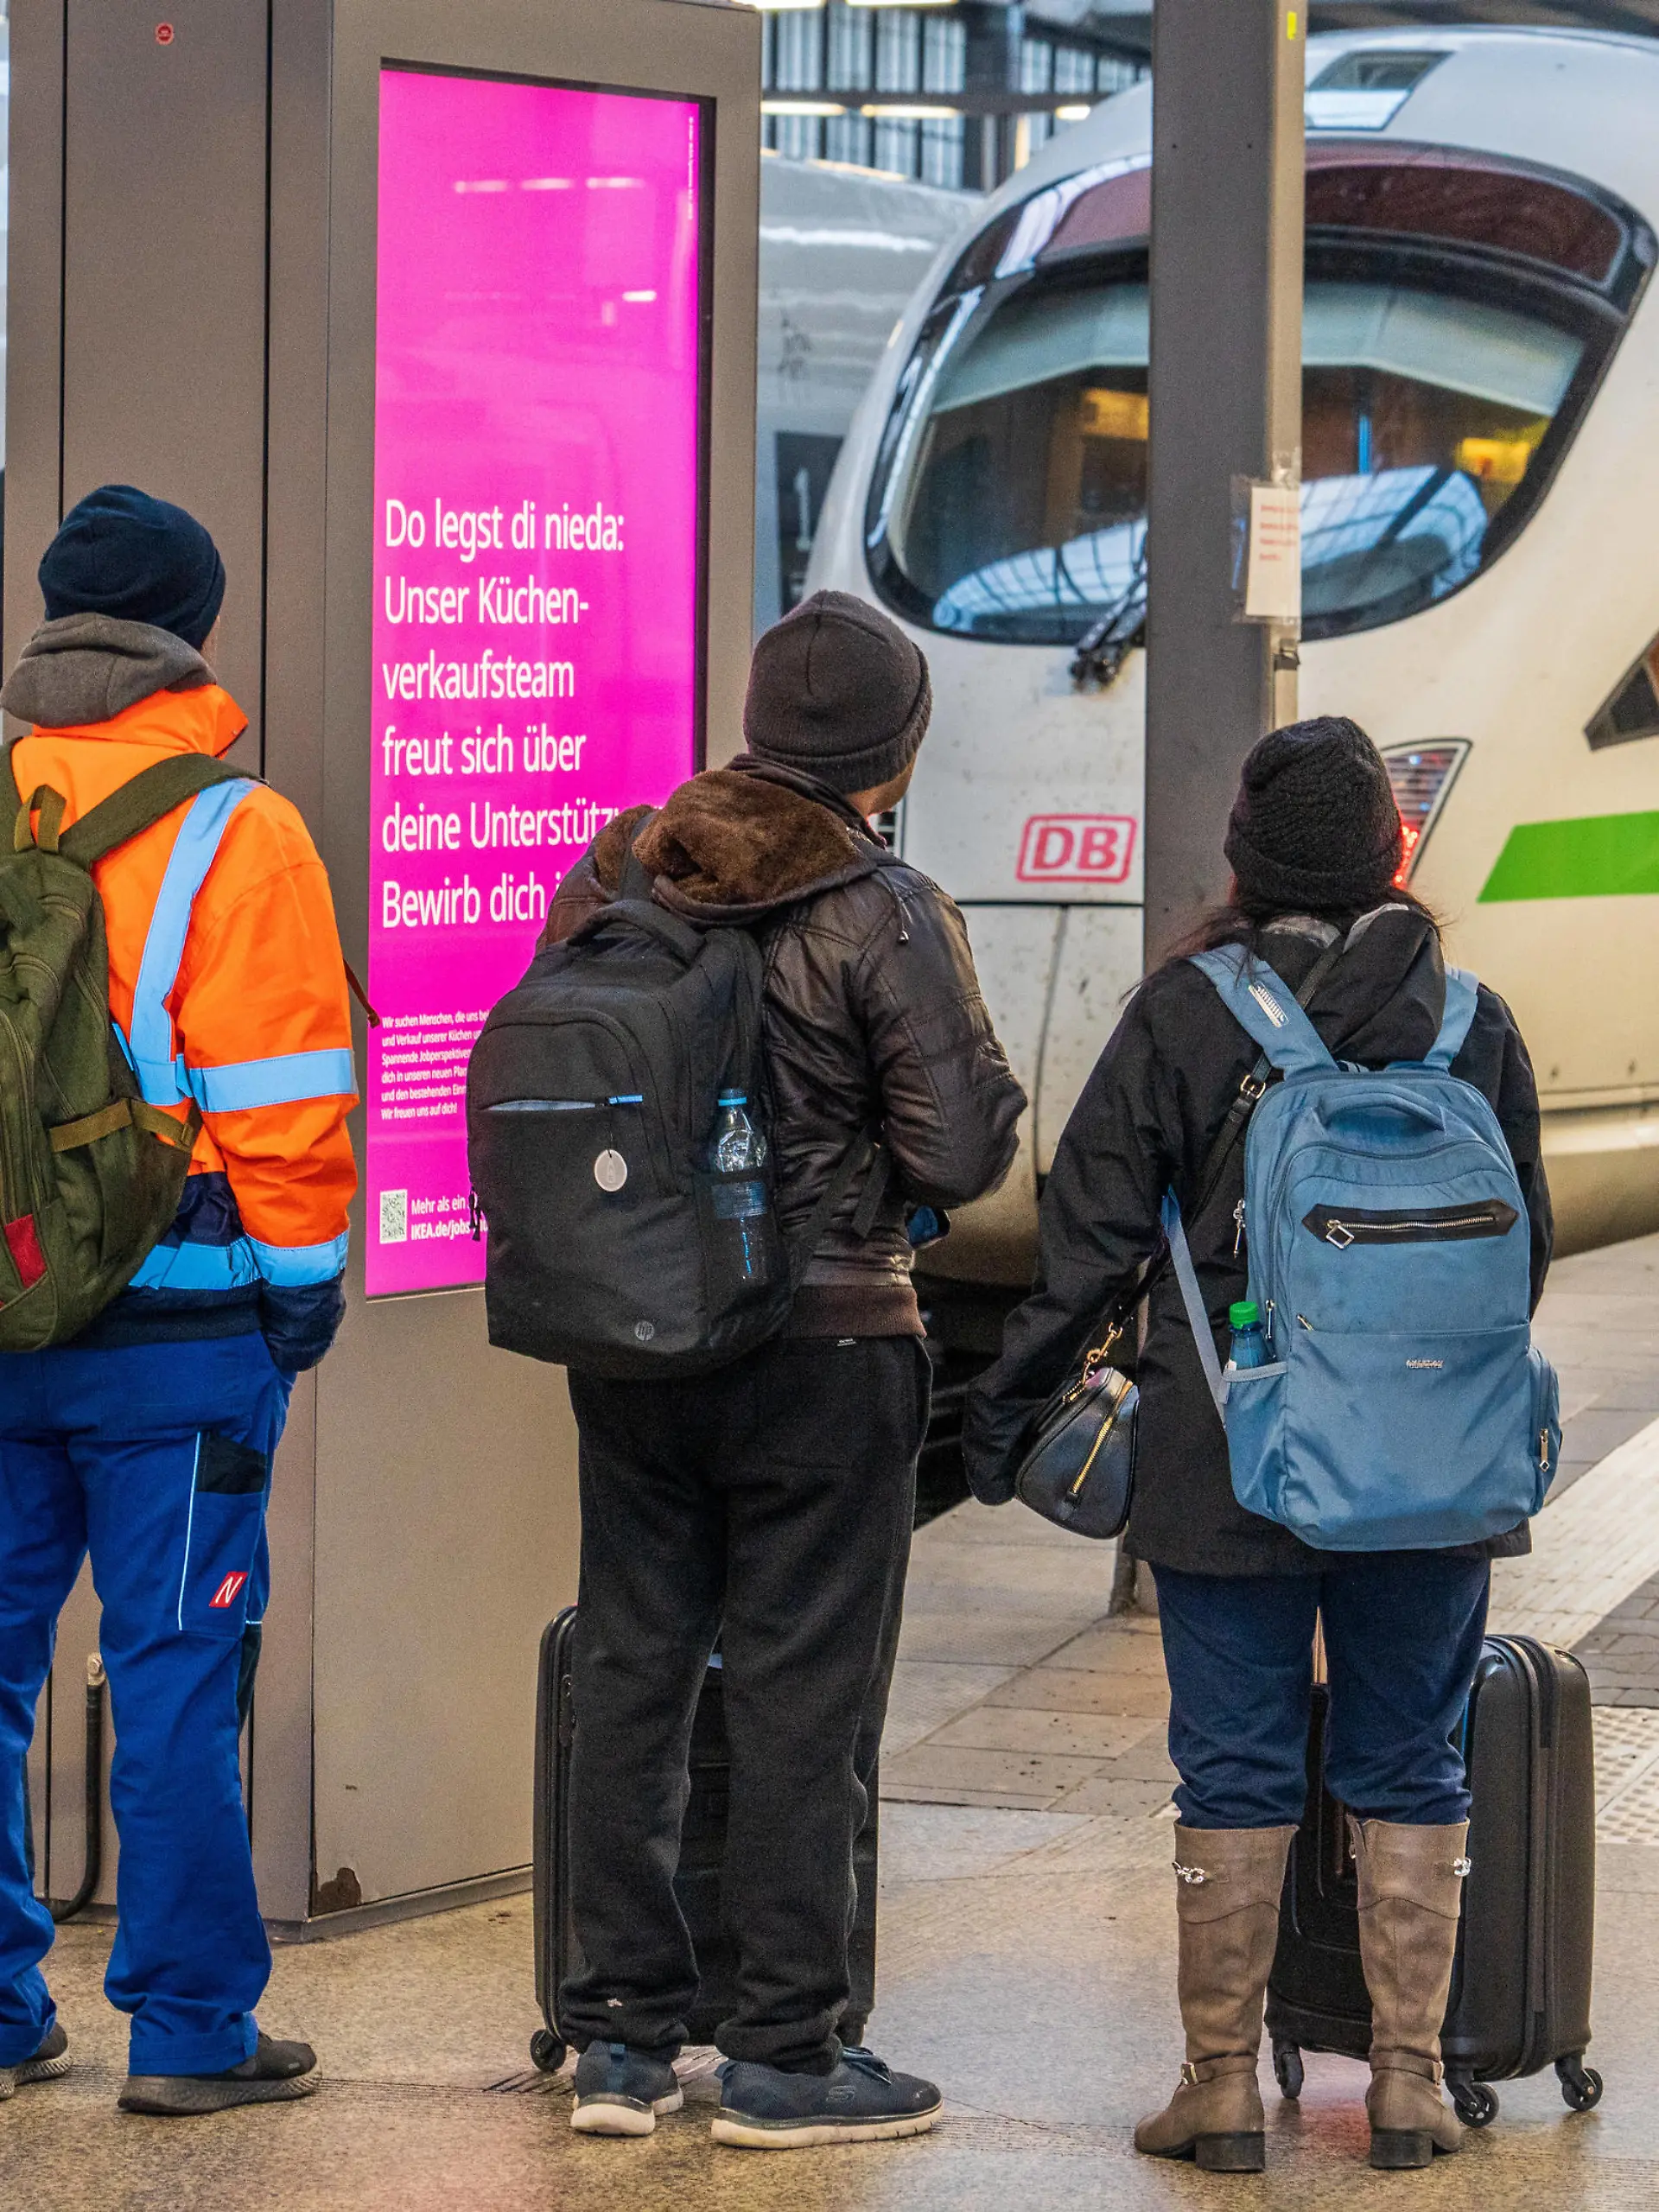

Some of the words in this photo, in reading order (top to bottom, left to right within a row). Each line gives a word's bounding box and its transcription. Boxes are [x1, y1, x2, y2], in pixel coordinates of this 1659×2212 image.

[385, 499, 426, 548] Do
[435, 497, 504, 563] legst
[512, 499, 536, 550] di
[544, 501, 624, 551] nieda:
[385, 575, 470, 624] Unser
[479, 574, 589, 624] Küchen-
[382, 648, 575, 700] verkaufsteam
[382, 725, 453, 776] freut
[461, 723, 513, 775] sich
[523, 722, 587, 772] über
[382, 801, 461, 853] deine
[1032, 826, 1119, 870] DB
[382, 873, 481, 929] Bewirb
[489, 871, 544, 922] dich
[382, 1016, 393, 1029] Wir
[395, 1014, 418, 1028] suchen
[454, 1011, 465, 1023] die
[466, 1011, 478, 1022] uns
[381, 1035, 396, 1047] und
[397, 1032, 422, 1046] Verkauf
[423, 1032, 447, 1044] unserer
[448, 1030, 473, 1042] Küchen
[381, 1051, 419, 1067] Spannende
[381, 1071, 396, 1084] dich
[397, 1071, 404, 1082] in
[404, 1069, 431, 1082] unseren
[432, 1067, 453, 1079] neuen
[380, 1089, 395, 1102] und
[396, 1088, 409, 1100] den
[380, 1108, 393, 1120] Wir
[394, 1106, 416, 1118] freuen
[416, 1105, 429, 1116] uns
[429, 1103, 441, 1116] auf
[410, 1198, 435, 1215] Mehr
[436, 1196, 450, 1212] als
[452, 1194, 466, 1210] ein
